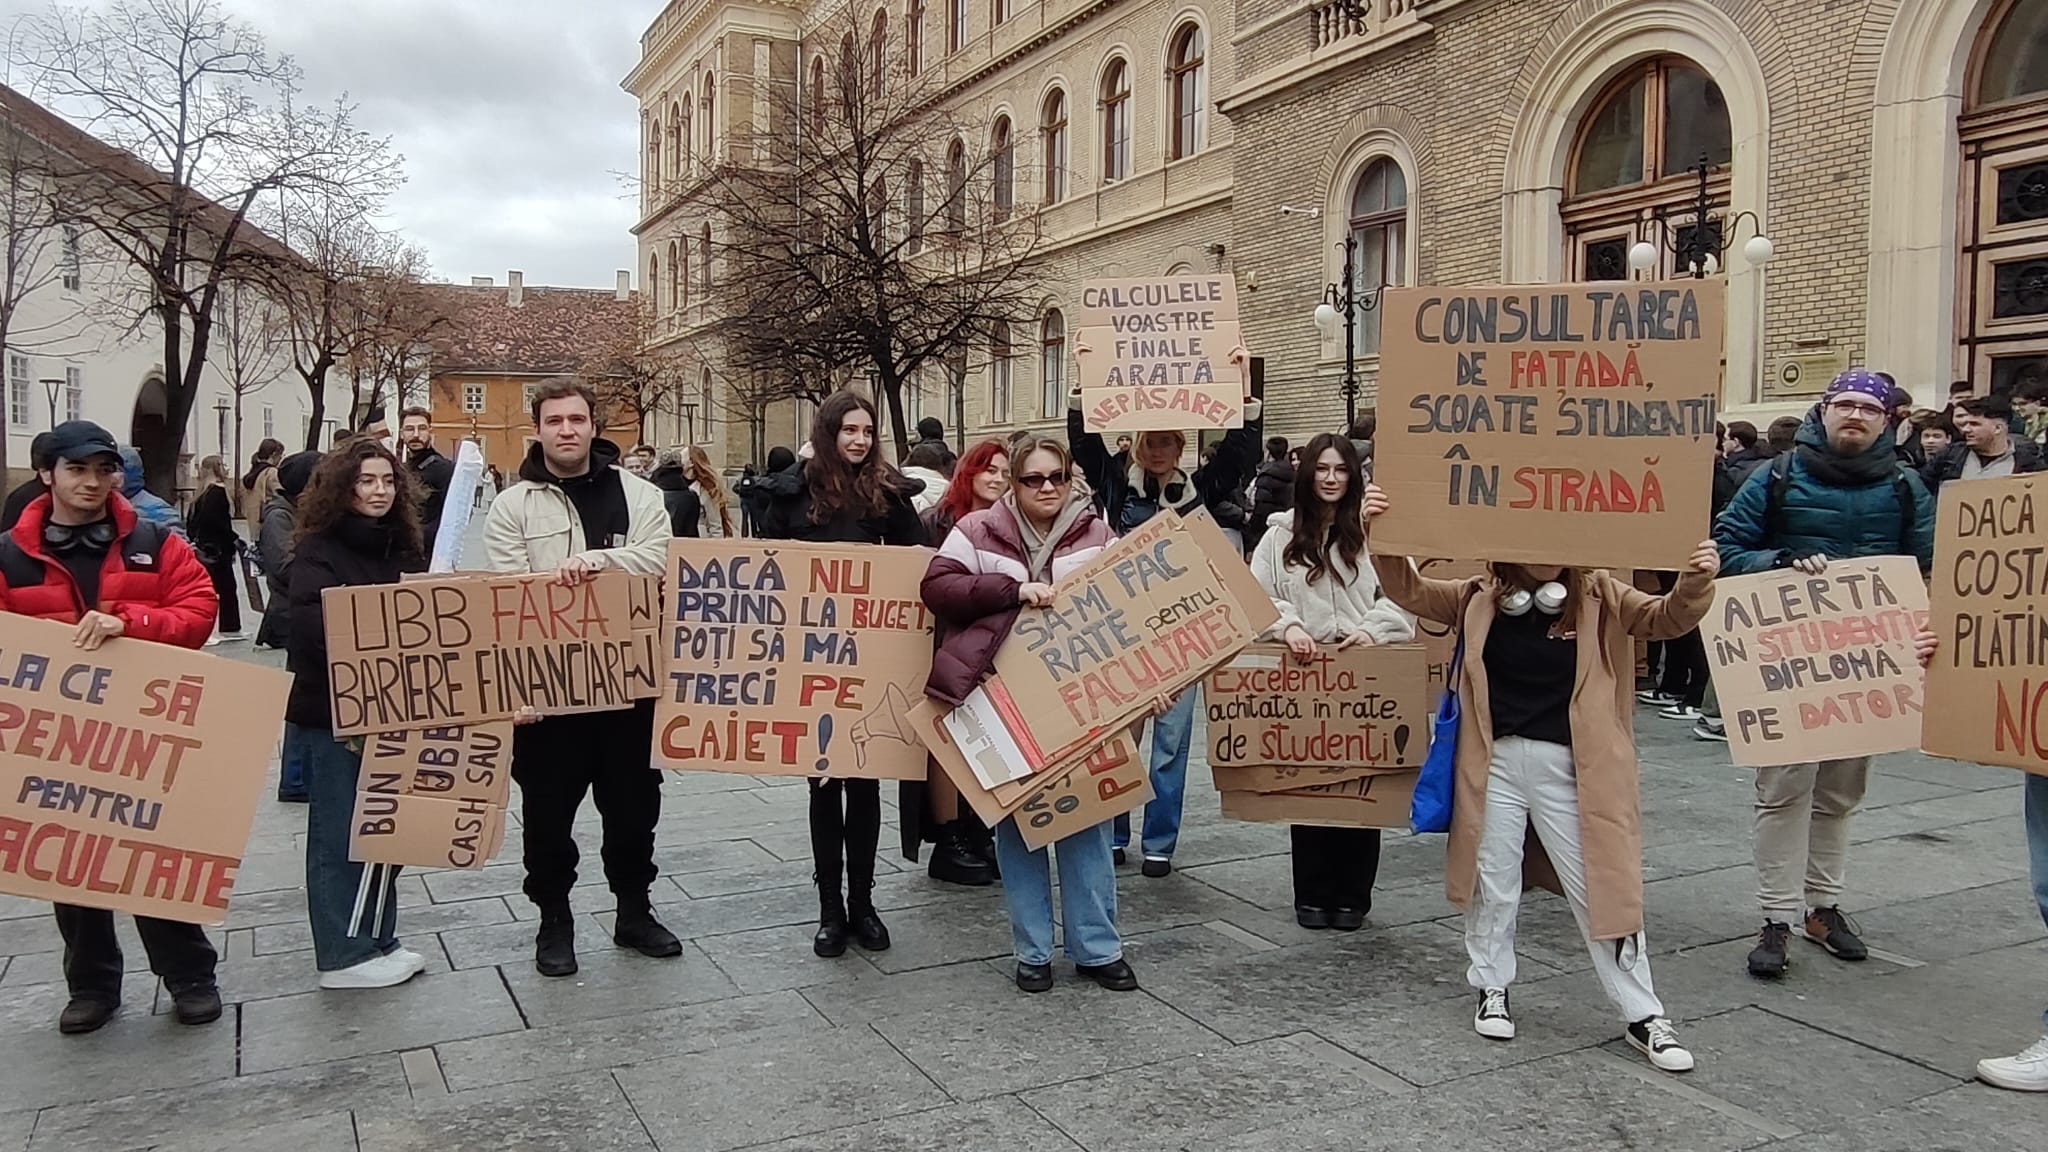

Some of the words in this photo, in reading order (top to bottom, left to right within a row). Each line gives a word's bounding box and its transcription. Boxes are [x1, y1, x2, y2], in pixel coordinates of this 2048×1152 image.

[1083, 282, 1222, 308] CALCULELE
[1415, 289, 1701, 344] CONSULTAREA
[1111, 311, 1215, 333] VOASTRE
[1106, 356, 1213, 386] ARATĂ
[1115, 336, 1202, 359] FINALE
[1457, 351, 1487, 386] DE
[1088, 386, 1237, 429] NEPĂSARE!
[1408, 394, 1538, 434] SCOATE
[1444, 443, 1499, 507] ÎN
[1509, 455, 1665, 513] STRADĂ
[1958, 481, 2035, 538] DACĂ
[678, 549, 786, 591] DACĂ
[809, 558, 871, 594] NU
[1112, 538, 1189, 599] FAC
[1954, 547, 2048, 600] COST
[351, 586, 472, 651] UBB
[490, 576, 609, 642] FĂRĂ
[676, 590, 786, 625] PRIND
[800, 597, 836, 627] LA
[1724, 566, 1898, 632] ALERTĂ
[674, 625, 736, 668] POȚI
[748, 627, 785, 662] SĂ
[803, 630, 858, 665] MĂ
[1039, 608, 1142, 682] RATE
[1145, 587, 1219, 640] pentru
[1713, 635, 1748, 667] ÎN
[331, 652, 465, 729] BARIERE
[475, 640, 634, 714] FINANCIARE
[670, 667, 777, 706] TRECI
[800, 675, 865, 711] PE
[1057, 604, 1243, 727] FACULTATE?
[1759, 643, 1902, 691] DIPLOMĂ
[59, 663, 113, 705] CE
[139, 674, 205, 727] SĂ
[1312, 698, 1331, 718] în
[1216, 723, 1247, 762] de
[1737, 707, 1783, 744] PE
[465, 732, 502, 787] SAU
[17, 775, 162, 831] PENTRU
[359, 773, 402, 836] BUN
[448, 797, 487, 868] CASH
